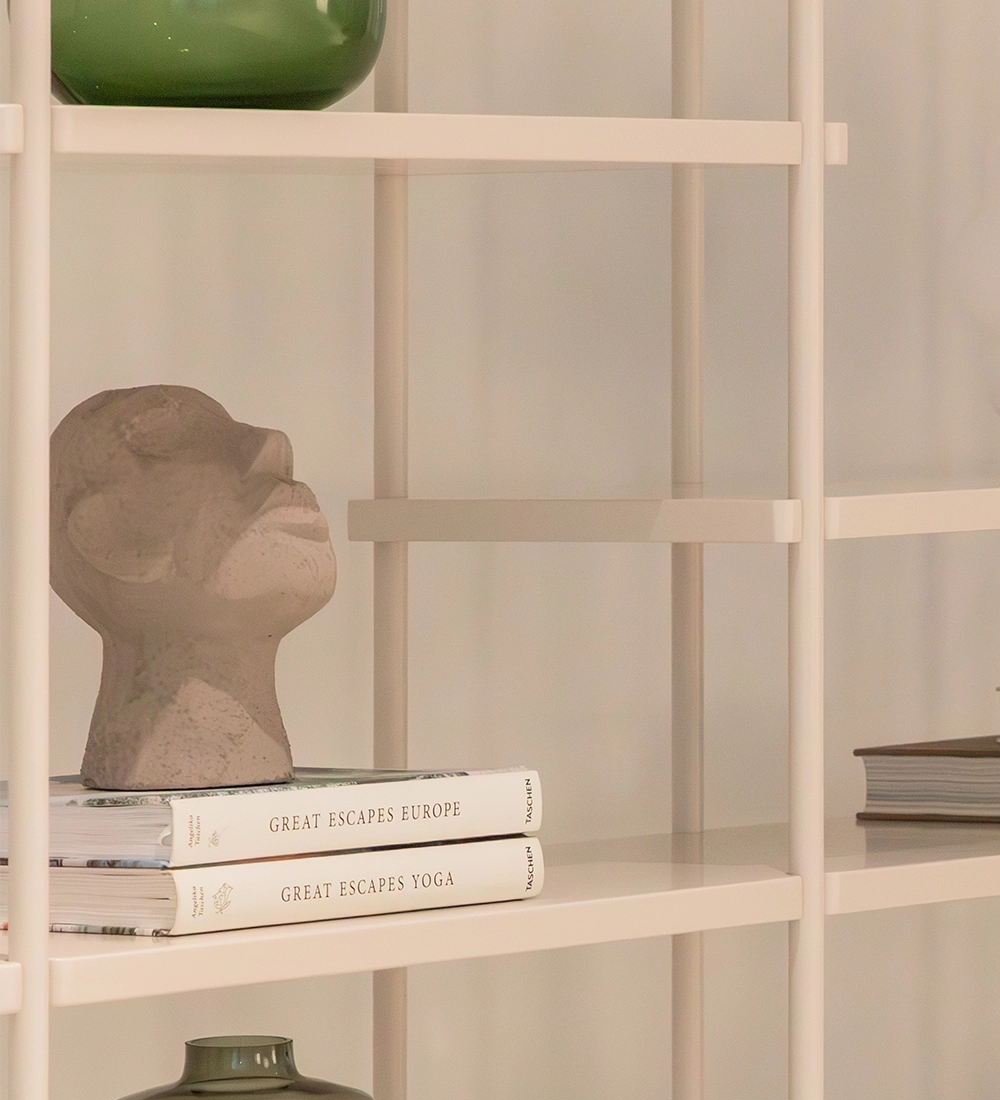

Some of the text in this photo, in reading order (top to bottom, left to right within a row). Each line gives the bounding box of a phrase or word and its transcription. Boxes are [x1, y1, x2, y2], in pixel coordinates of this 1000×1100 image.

[269, 801, 462, 833] GREAT ESCAPES EUROPE
[525, 778, 533, 824] TASCHEN
[280, 871, 455, 903] GREAT ESCAPES YOGA
[525, 846, 534, 892] TASCHEN
